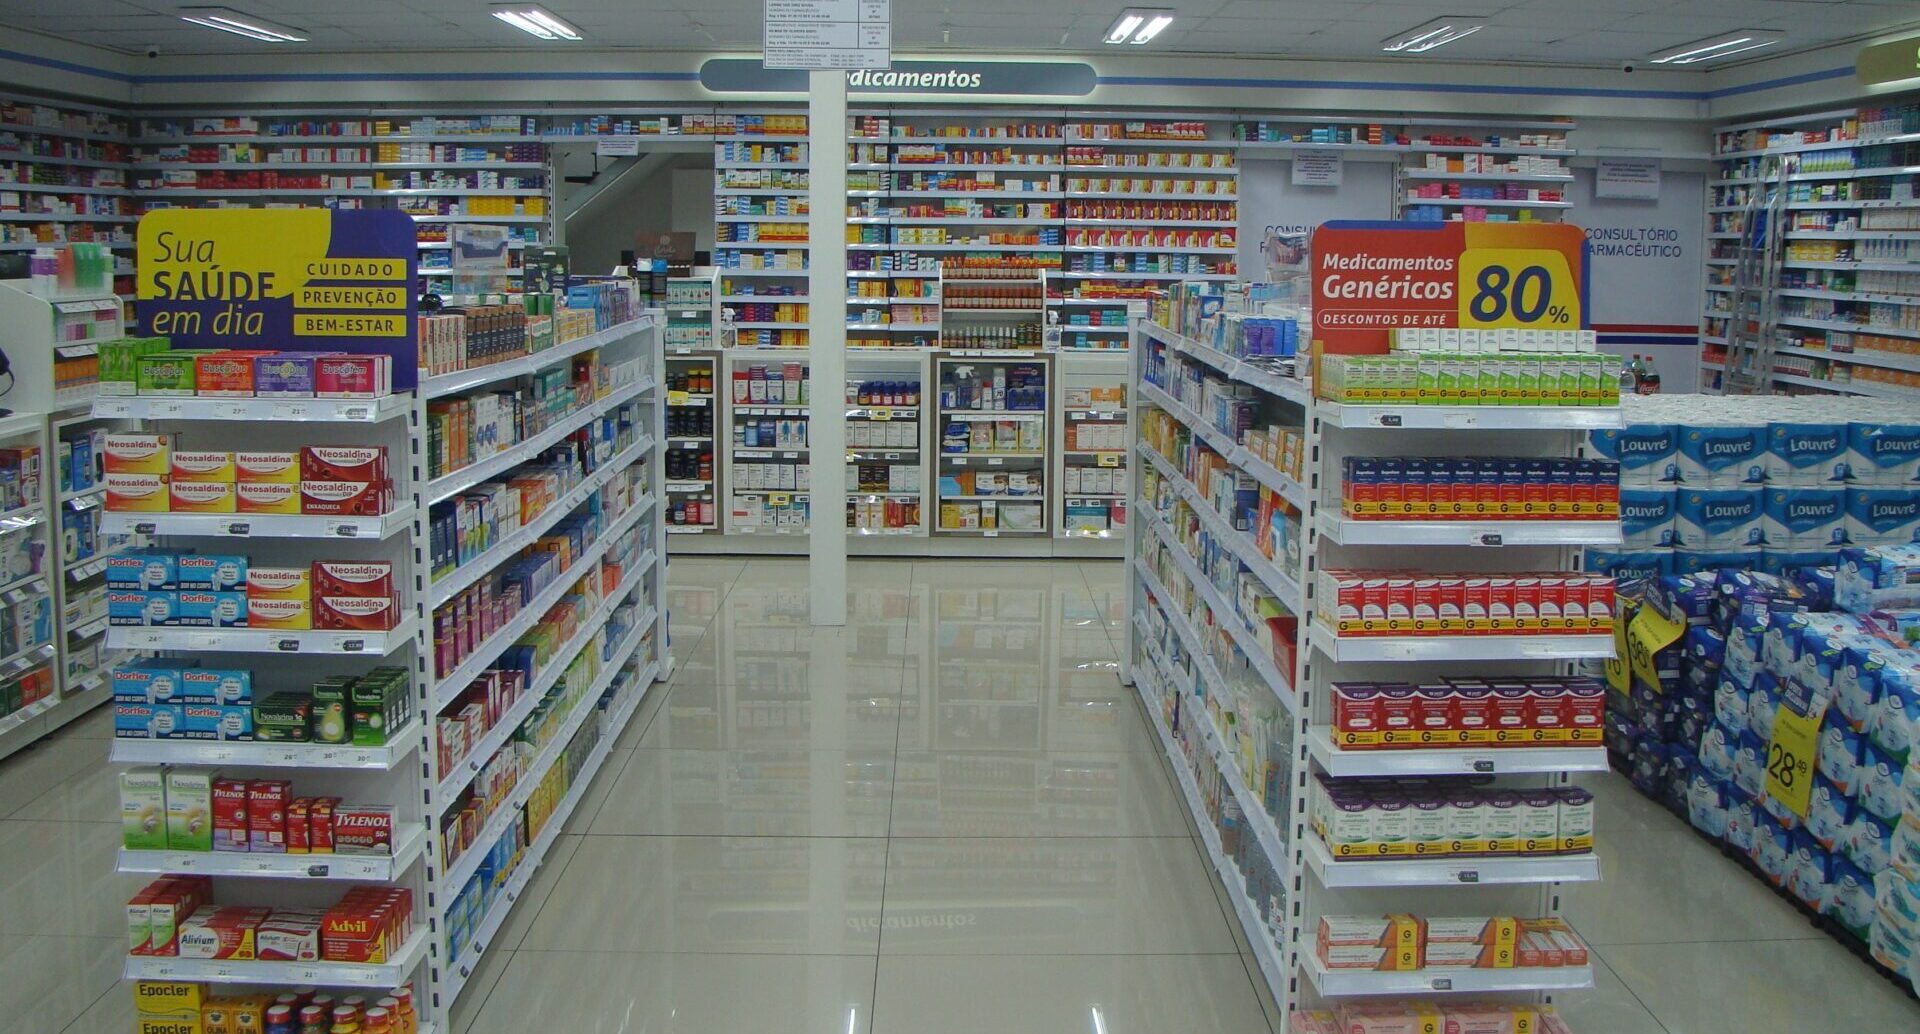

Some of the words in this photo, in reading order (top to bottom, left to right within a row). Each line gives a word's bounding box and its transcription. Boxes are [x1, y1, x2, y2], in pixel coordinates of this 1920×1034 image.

[847, 69, 982, 90] dicamentos
[153, 230, 214, 263] Sua
[1589, 243, 1681, 258] ARMACÊUTICO
[1322, 253, 1453, 270] Medicamentos
[307, 263, 393, 276] CUIDADO
[153, 265, 275, 301] SAÚDE
[1322, 274, 1453, 300] Genéricos
[303, 288, 397, 307] PREVENÇÃO
[153, 312, 200, 335] em
[213, 305, 263, 336] dia
[1322, 314, 1398, 326] DESCONTOS
[1403, 314, 1419, 325] DE
[1423, 312, 1447, 325] ATÉ
[306, 318, 393, 332] BEM-ESTAR
[107, 440, 158, 449] Neosaldina
[1620, 439, 1668, 453] Louvre
[1705, 440, 1751, 455] Louvre
[1790, 438, 1836, 452] Louvre
[1876, 438, 1920, 452] Louvre
[175, 454, 226, 463] Neosaldina
[240, 454, 290, 463] Neosaldina
[319, 449, 372, 459] Neosaldina
[108, 479, 159, 488] Neosaldina
[303, 481, 358, 492] Neosaldina
[175, 484, 226, 494] Neosaldina
[240, 485, 291, 494] Neosaldina
[1354, 503, 1362, 512] G
[1379, 503, 1387, 512] G
[1404, 503, 1412, 512] G
[1429, 503, 1437, 512] G
[1453, 503, 1461, 512] G
[1477, 503, 1485, 512] G
[1500, 503, 1508, 512] G
[1524, 503, 1533, 512] G
[1549, 503, 1557, 512] G
[1572, 503, 1580, 512] G
[1596, 503, 1604, 512] G
[1620, 503, 1664, 518] ouvre
[1706, 503, 1751, 518] Louvre
[1790, 503, 1834, 517] Louvre
[1873, 503, 1915, 517] Louvre
[109, 558, 143, 567] Dorflex
[181, 558, 215, 567] Dorflex
[330, 564, 383, 576] Neosaldina
[250, 571, 300, 581] Neosaldina
[111, 593, 145, 602] Dorflex
[181, 593, 215, 602] Dorflex
[251, 600, 302, 610] Neosaldina
[331, 598, 384, 608] Neosaldina
[1339, 621, 1348, 630] G
[1364, 620, 1373, 629] G
[1389, 620, 1398, 629] G
[1415, 620, 1424, 629] G
[1440, 619, 1449, 628] G
[1466, 620, 1474, 628] G
[1491, 619, 1499, 628] G
[1516, 619, 1525, 628] G
[1541, 619, 1549, 628] G
[1565, 619, 1574, 628] G
[1590, 618, 1598, 627] G
[115, 671, 149, 680] Dorflex
[185, 672, 218, 681] Dorflex
[117, 706, 150, 715] Dorflex
[187, 708, 219, 716] Dorflex
[1346, 733, 1356, 743] G
[1384, 732, 1394, 742] G
[1421, 731, 1431, 741] G
[1459, 731, 1469, 741] G
[1496, 730, 1506, 741] G
[1533, 730, 1543, 740] G
[1571, 729, 1581, 739] G
[1768, 743, 1796, 789] 28
[213, 789, 245, 798] TYLENOL
[249, 790, 281, 800] TYLENOL
[335, 813, 389, 827] TYLENOL
[1378, 843, 1388, 853] G
[1416, 842, 1425, 852] G
[1452, 841, 1461, 851] G
[1489, 840, 1498, 850] G
[1526, 840, 1536, 850] G
[1565, 838, 1574, 848] G
[1341, 844, 1350, 854] G
[327, 919, 366, 933] Advil
[1402, 929, 1412, 940] G
[1501, 927, 1511, 937] G
[181, 934, 216, 946] Alivium
[1402, 952, 1412, 962] G
[1499, 950, 1508, 960] G
[139, 985, 190, 998] Epocler
[143, 1022, 193, 1034] Epocler
[1424, 1023, 1433, 1033] G
[1518, 1019, 1527, 1029] G
